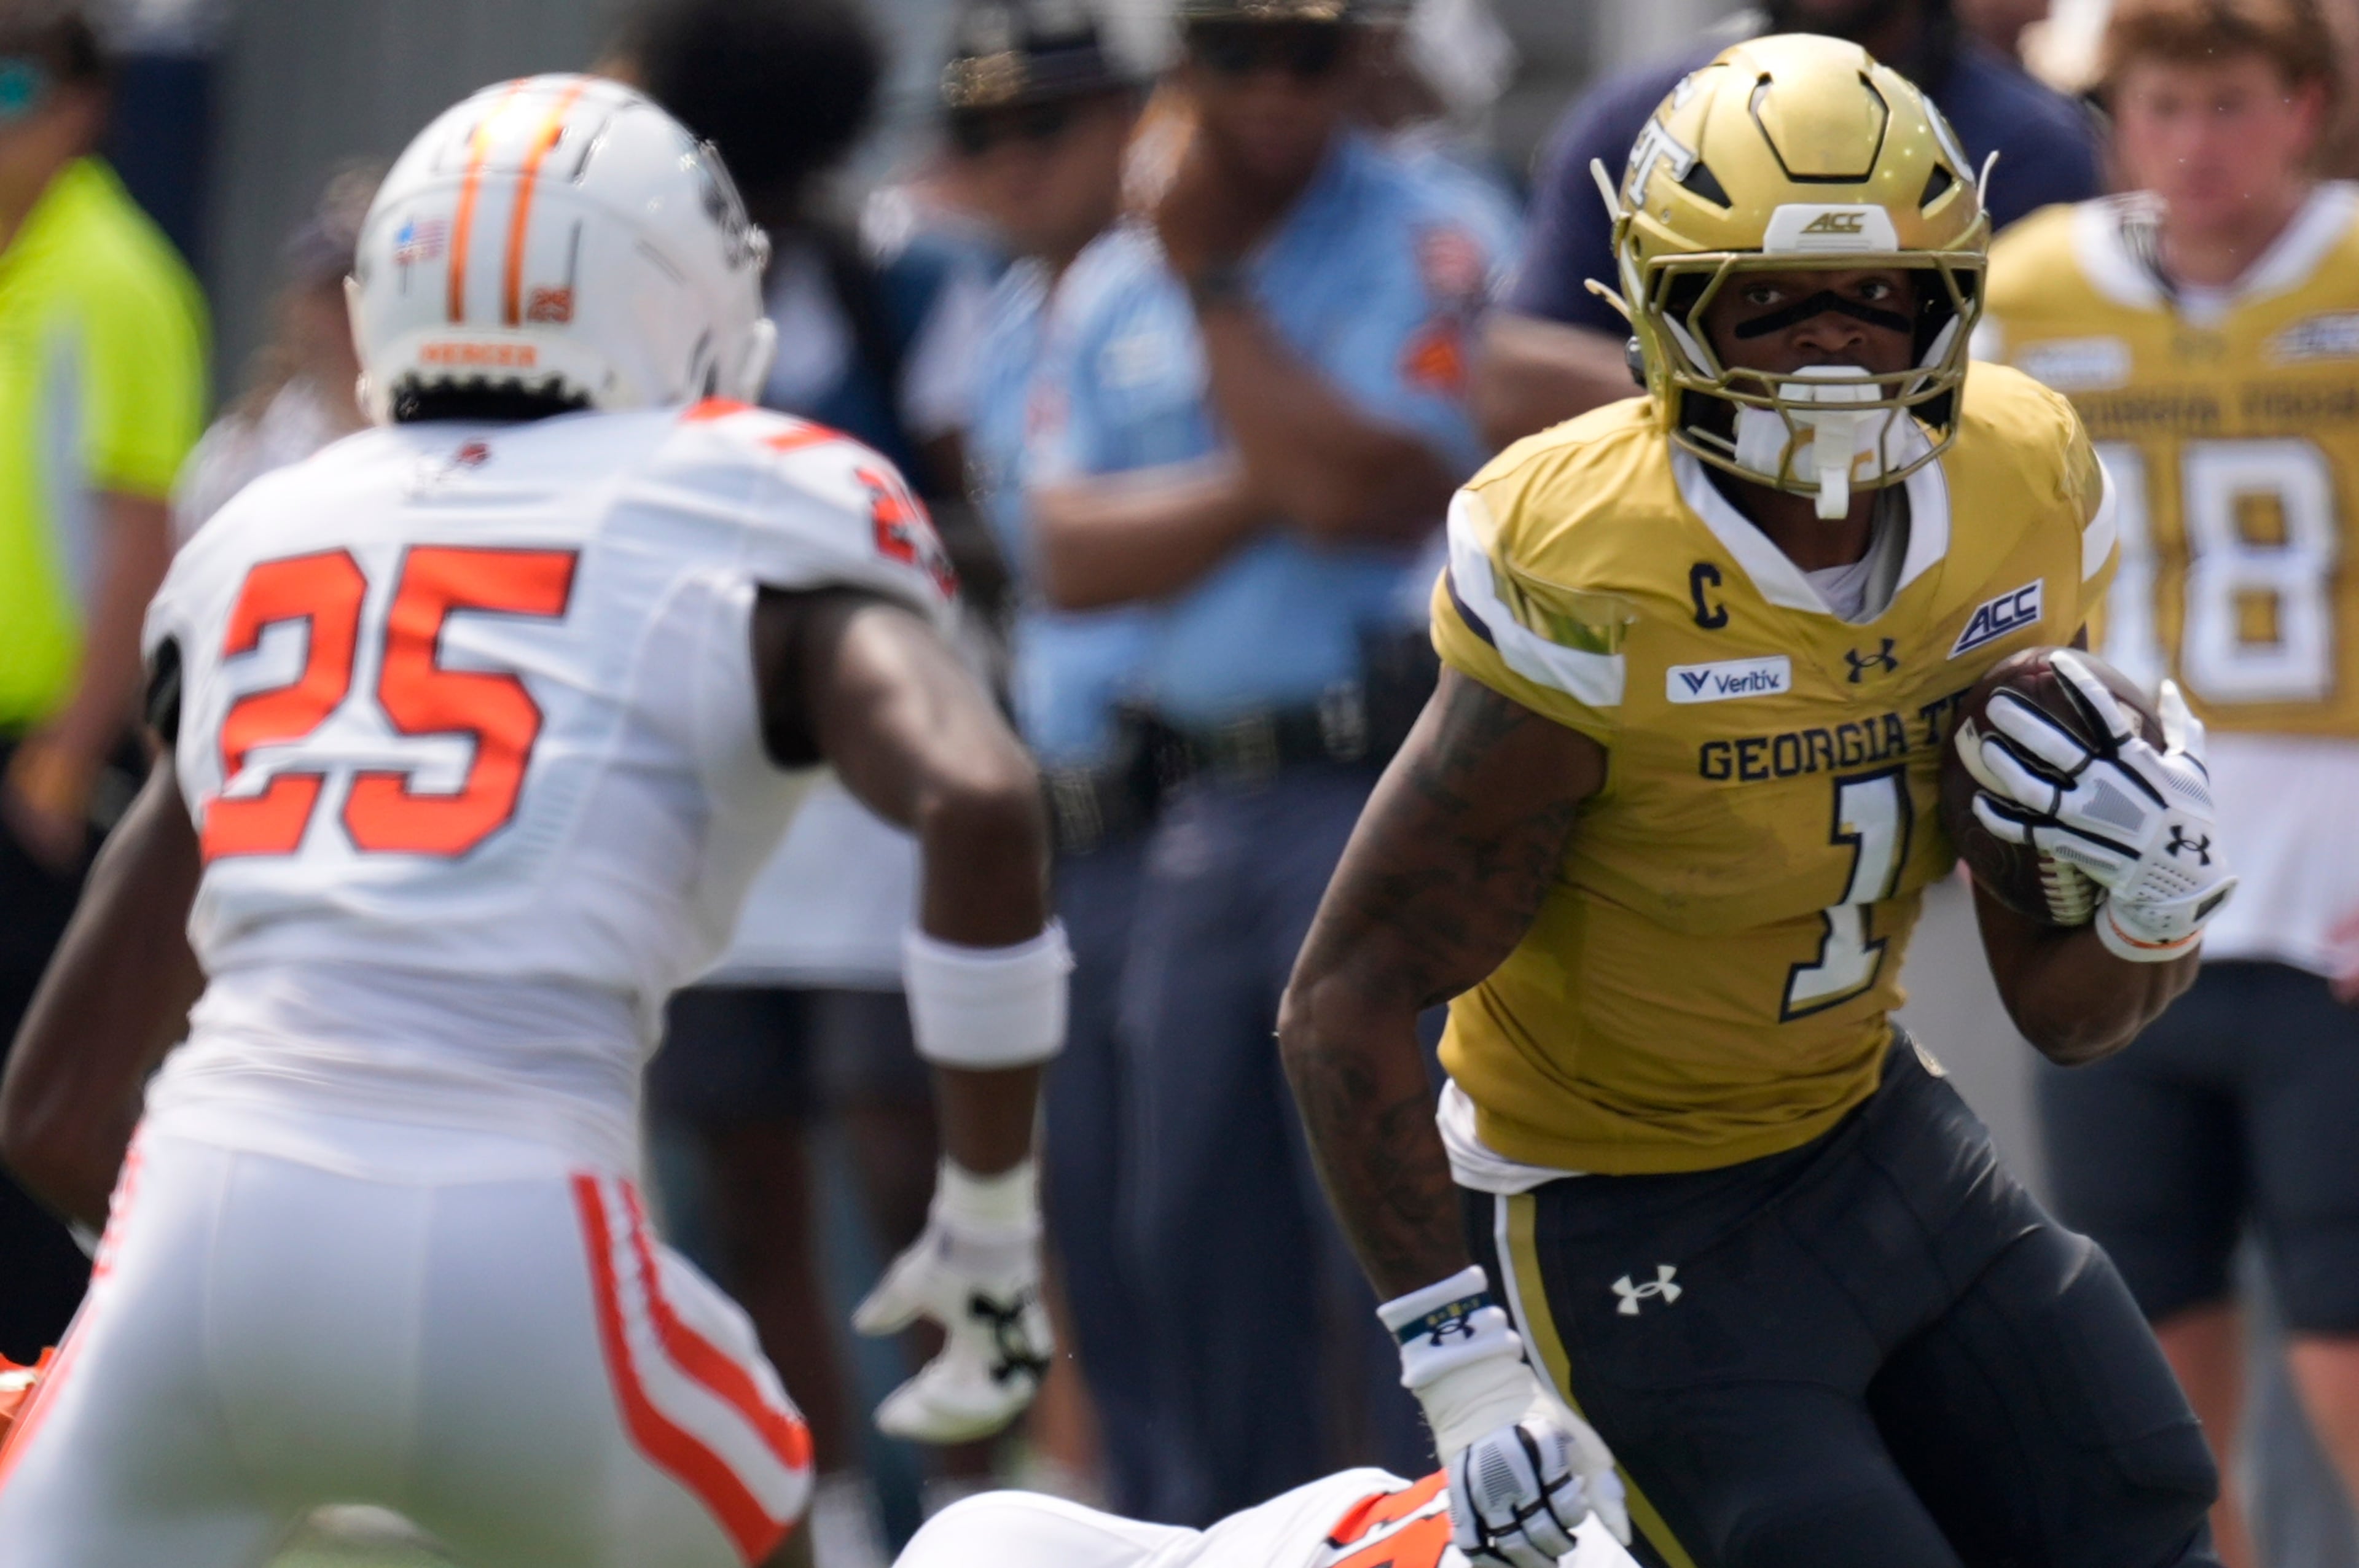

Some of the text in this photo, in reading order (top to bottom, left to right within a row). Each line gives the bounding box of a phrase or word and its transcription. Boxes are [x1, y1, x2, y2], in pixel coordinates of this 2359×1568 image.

[1799, 212, 1867, 233] ACC
[1689, 562, 1728, 629] C
[1956, 583, 2037, 650] ACC
[201, 543, 581, 861] 25
[1699, 712, 1909, 782] GEORGIA
[1778, 763, 1914, 1024] 1
